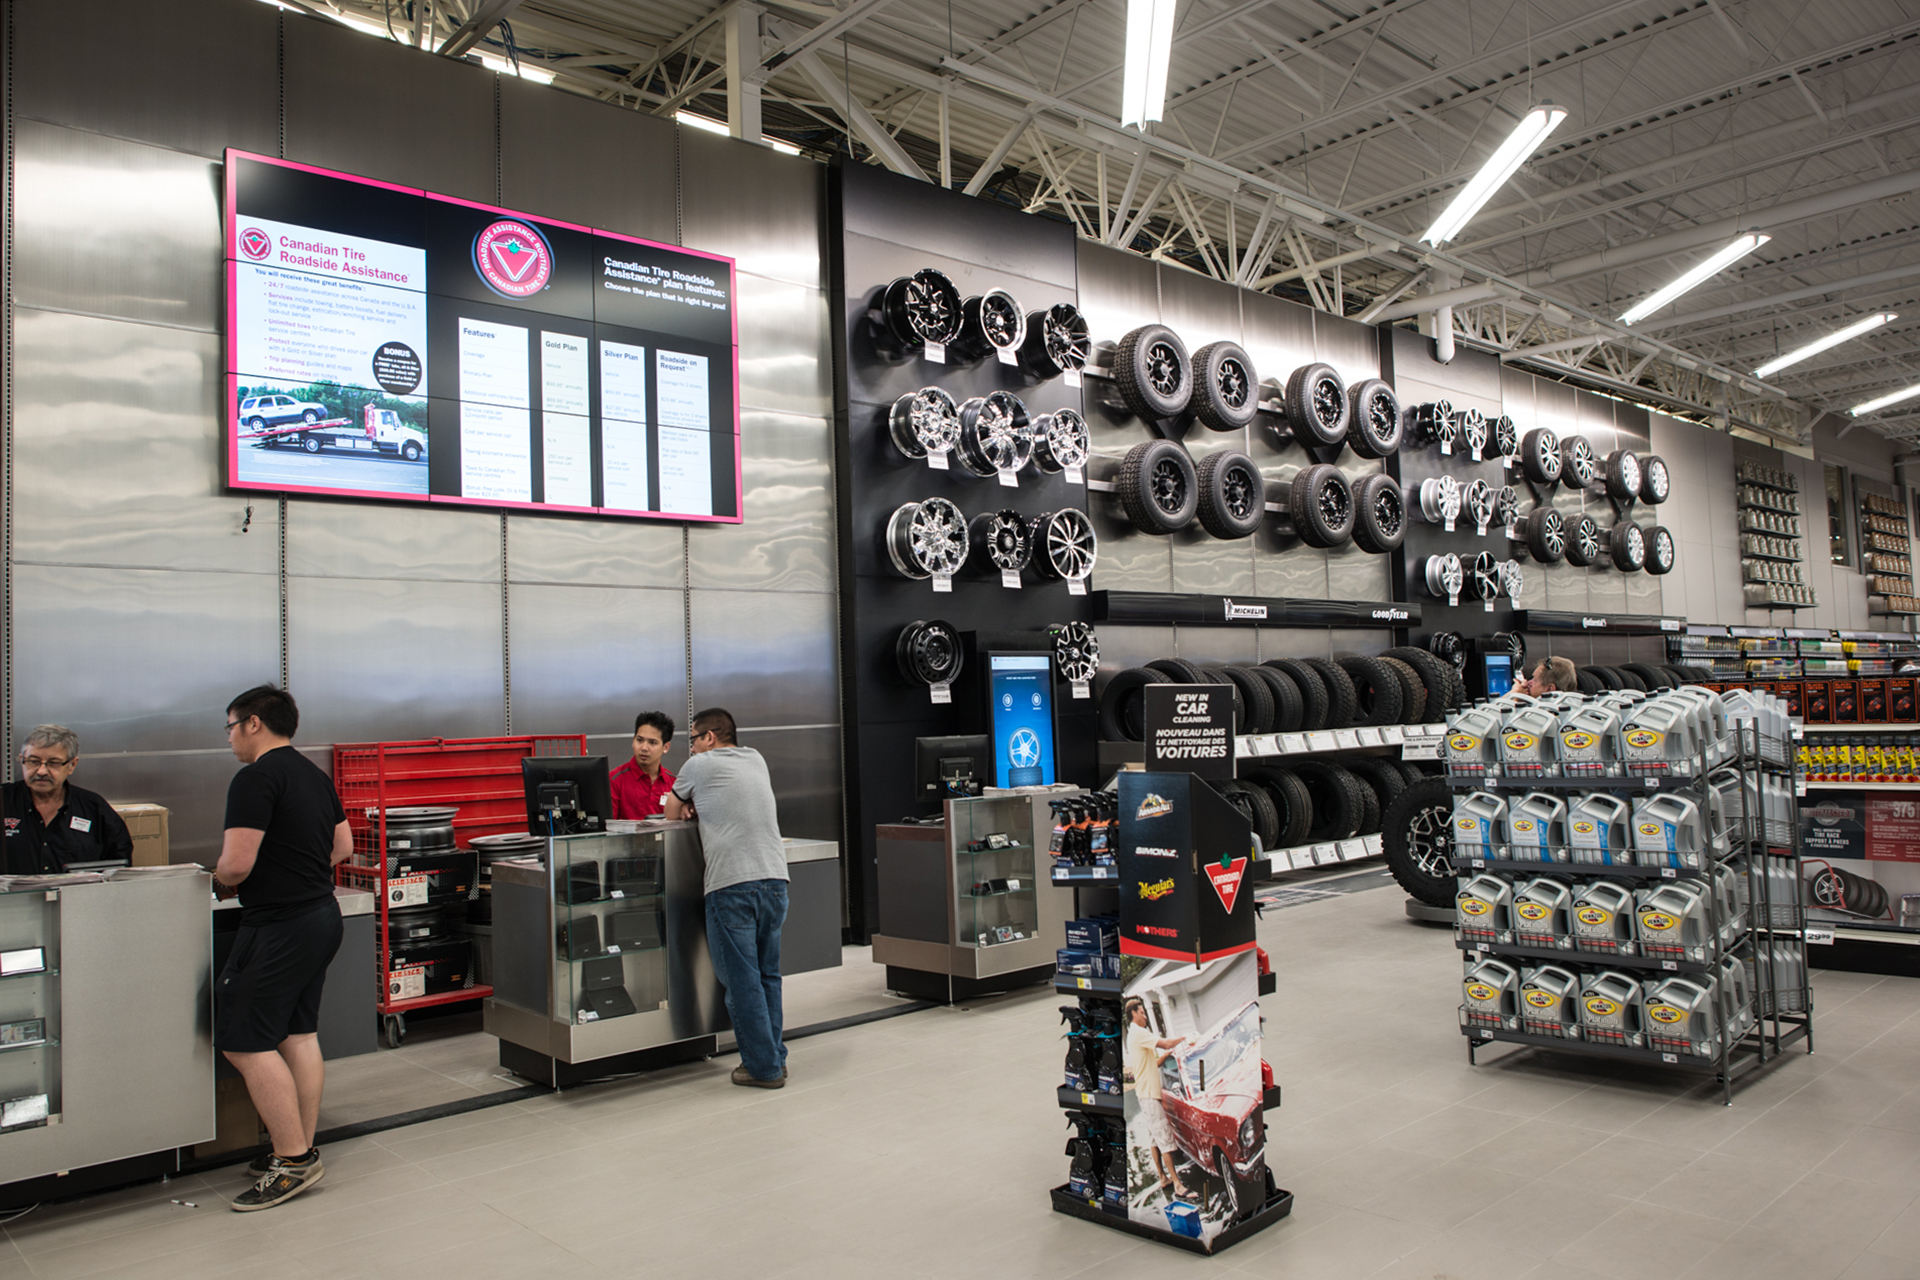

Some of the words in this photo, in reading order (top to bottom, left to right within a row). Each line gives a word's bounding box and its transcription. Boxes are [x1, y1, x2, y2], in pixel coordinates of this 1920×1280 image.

[280, 236, 338, 256] Canadian
[342, 246, 366, 261] Tire
[481, 231, 494, 269] ROADSIDE
[492, 224, 536, 243] ASSISTANCE
[280, 250, 338, 271] Roadside
[603, 256, 650, 274] Canadian
[651, 266, 671, 278] Tire
[672, 270, 715, 287] Roadside
[255, 268, 267, 276] You
[280, 273, 302, 281] receive
[303, 276, 320, 284] these
[321, 279, 338, 288] great
[489, 271, 524, 293] CANADIAN
[524, 279, 541, 292] TIRE
[604, 281, 631, 292] Choose
[632, 286, 644, 295] the
[645, 289, 661, 299] plan
[661, 292, 676, 301] that
[684, 296, 701, 306] right
[701, 299, 711, 308] for
[662, 279, 683, 290] plan
[684, 282, 726, 298] features:
[268, 292, 293, 300] Services
[335, 302, 354, 311] battery
[284, 284, 309, 293] roadside
[310, 288, 340, 298] assistance
[341, 293, 359, 301] across
[360, 295, 380, 304] Canada
[392, 300, 400, 308] the
[291, 311, 311, 319] service
[268, 318, 296, 327] Unlimited
[319, 325, 344, 334] Canadian
[463, 327, 495, 339] Features
[268, 336, 290, 345] Protect
[545, 340, 561, 349] Gold
[562, 343, 578, 352] Plan
[383, 347, 411, 358] BONUS
[604, 350, 622, 359] Silver
[624, 353, 638, 361] Plan
[269, 355, 280, 363] Trip
[280, 357, 305, 366] planning
[660, 354, 688, 365] Roadside
[269, 366, 295, 375] Preferred
[1233, 607, 1265, 615] MICHELIN
[1174, 693, 1198, 702] NEW
[1198, 693, 1210, 702] IN
[1176, 702, 1208, 715] CAR
[1172, 715, 1212, 724] CLEANING
[1155, 729, 1202, 737] NOUVEAU
[1202, 728, 1226, 736] DANS
[1631, 734, 1653, 743] PENNZOIL
[1167, 738, 1212, 746] NETTOYAGE
[1509, 738, 1529, 746] PENNZOIL
[1568, 736, 1589, 744] PENNZOIL
[1156, 746, 1227, 759] VOITURES
[1893, 801, 1915, 818] 375
[1213, 871, 1240, 885] CANADIAN
[1221, 883, 1234, 895] TIRE
[1522, 907, 1543, 915] PENNZOIL
[1582, 912, 1604, 920] PENNZOIL
[1647, 917, 1670, 925] PENNZOIL
[1136, 924, 1178, 938] MOTHERS
